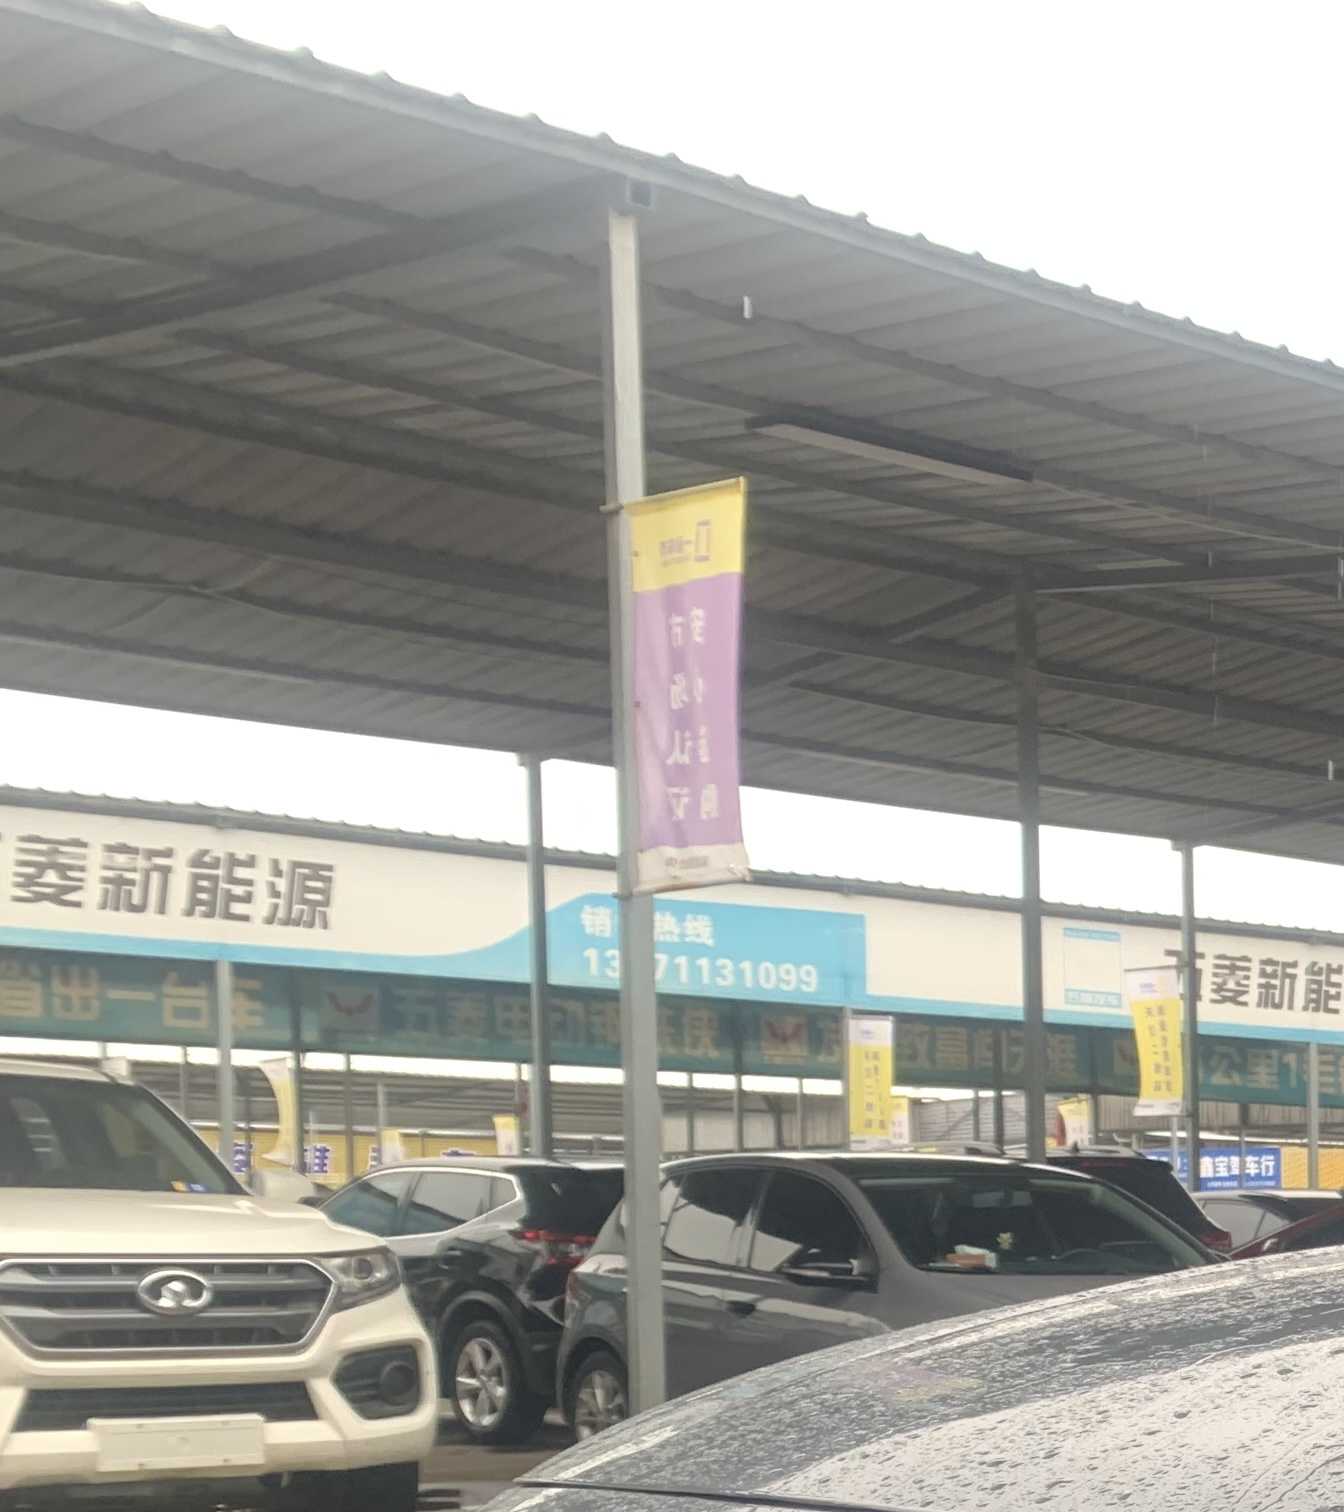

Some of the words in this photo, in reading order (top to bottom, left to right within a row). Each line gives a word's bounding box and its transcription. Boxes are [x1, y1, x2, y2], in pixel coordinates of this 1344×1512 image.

[0, 833, 334, 930] 菱新能源
[580, 904, 716, 946] 销热线
[583, 948, 818, 993] 1371131099
